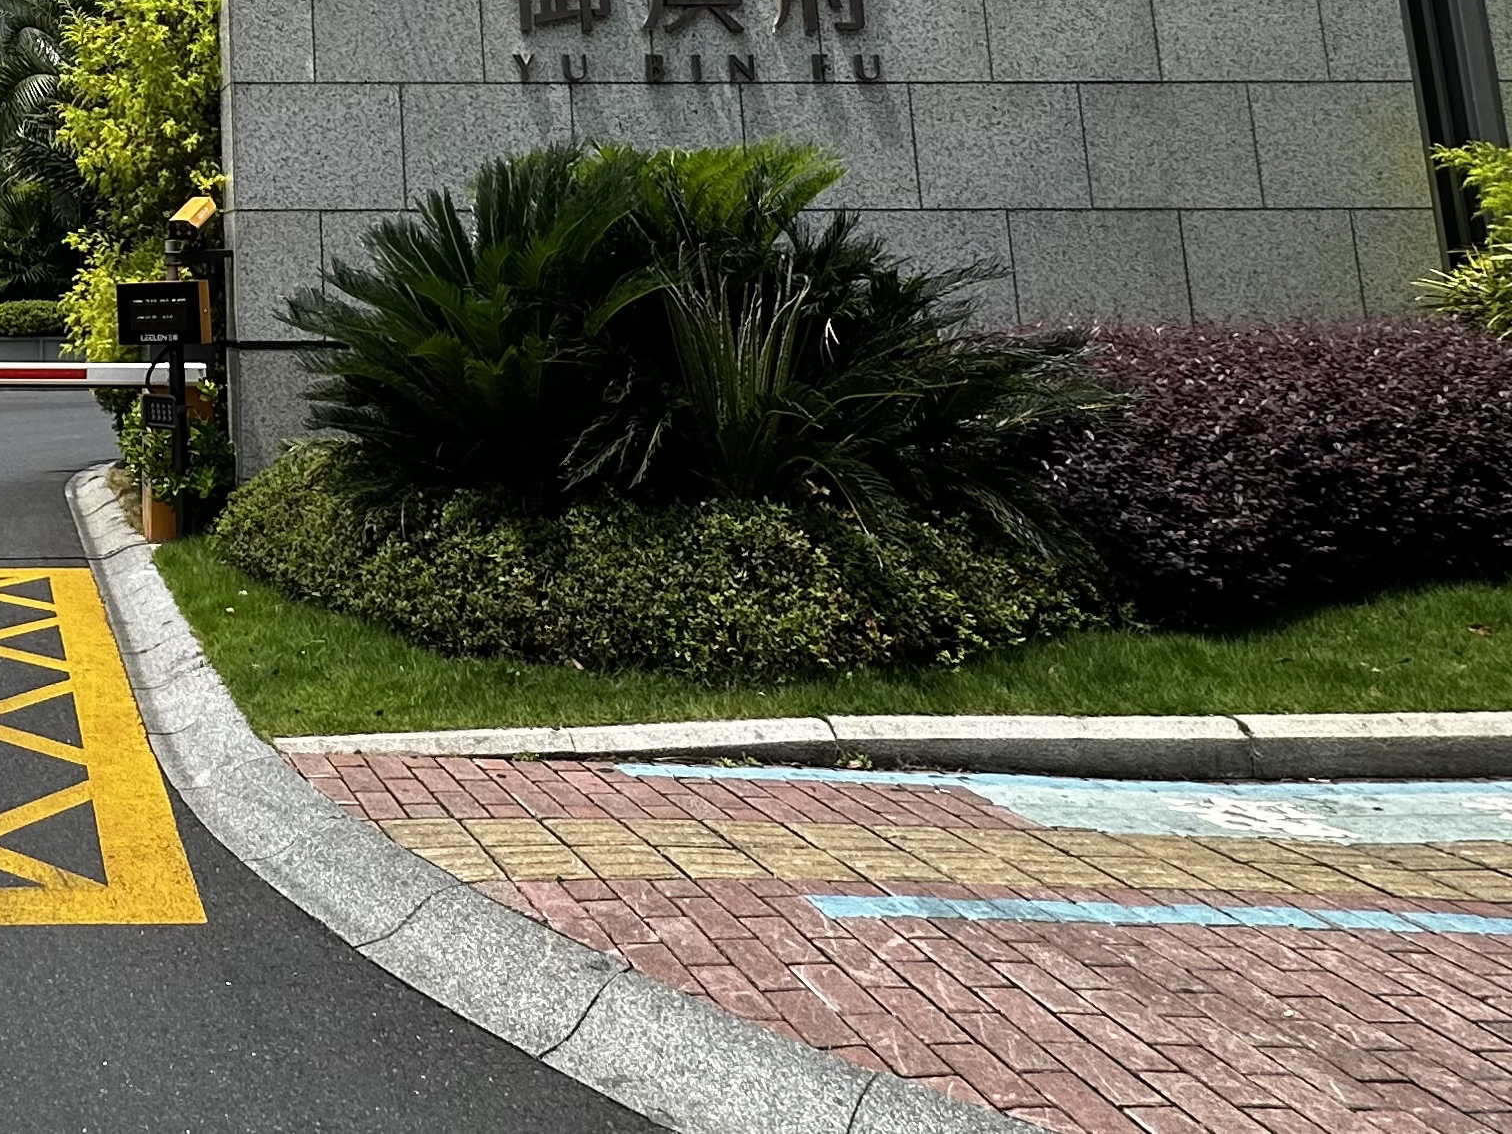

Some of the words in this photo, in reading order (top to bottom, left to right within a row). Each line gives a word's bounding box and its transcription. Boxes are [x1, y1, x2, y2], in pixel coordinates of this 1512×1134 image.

[512, 54, 587, 82] YU
[645, 54, 756, 82] BIN
[811, 54, 880, 82] FU
